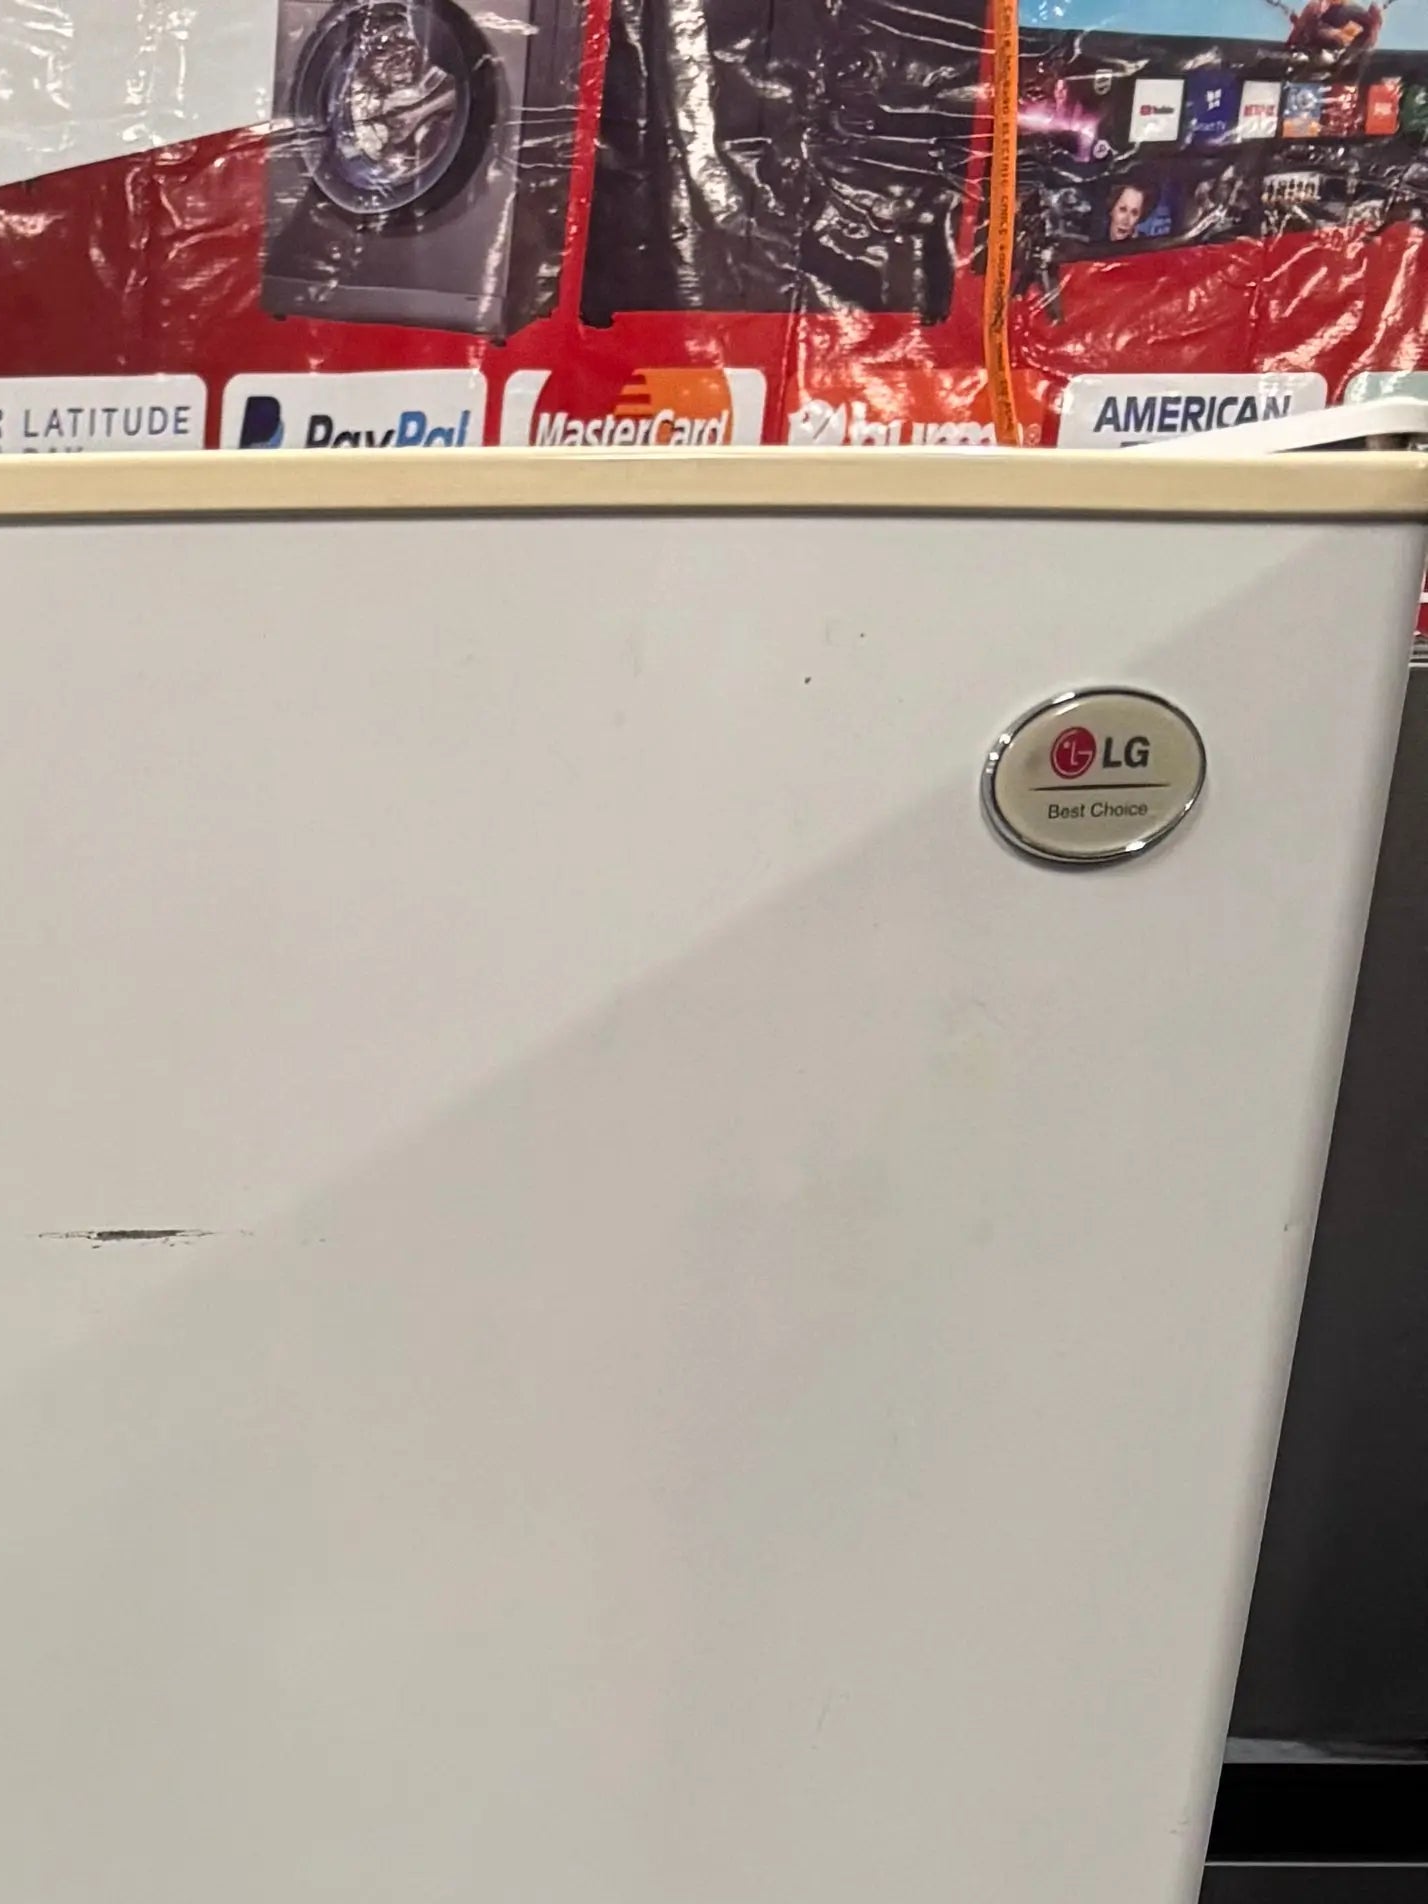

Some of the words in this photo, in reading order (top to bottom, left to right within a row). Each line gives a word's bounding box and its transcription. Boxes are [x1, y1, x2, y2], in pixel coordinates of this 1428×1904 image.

[23, 406, 191, 438] LATITUDE
[1094, 396, 1291, 432] AMERICAN
[1102, 736, 1150, 768] LG
[1048, 805, 1085, 819] Best
[1090, 802, 1147, 817] Choice
